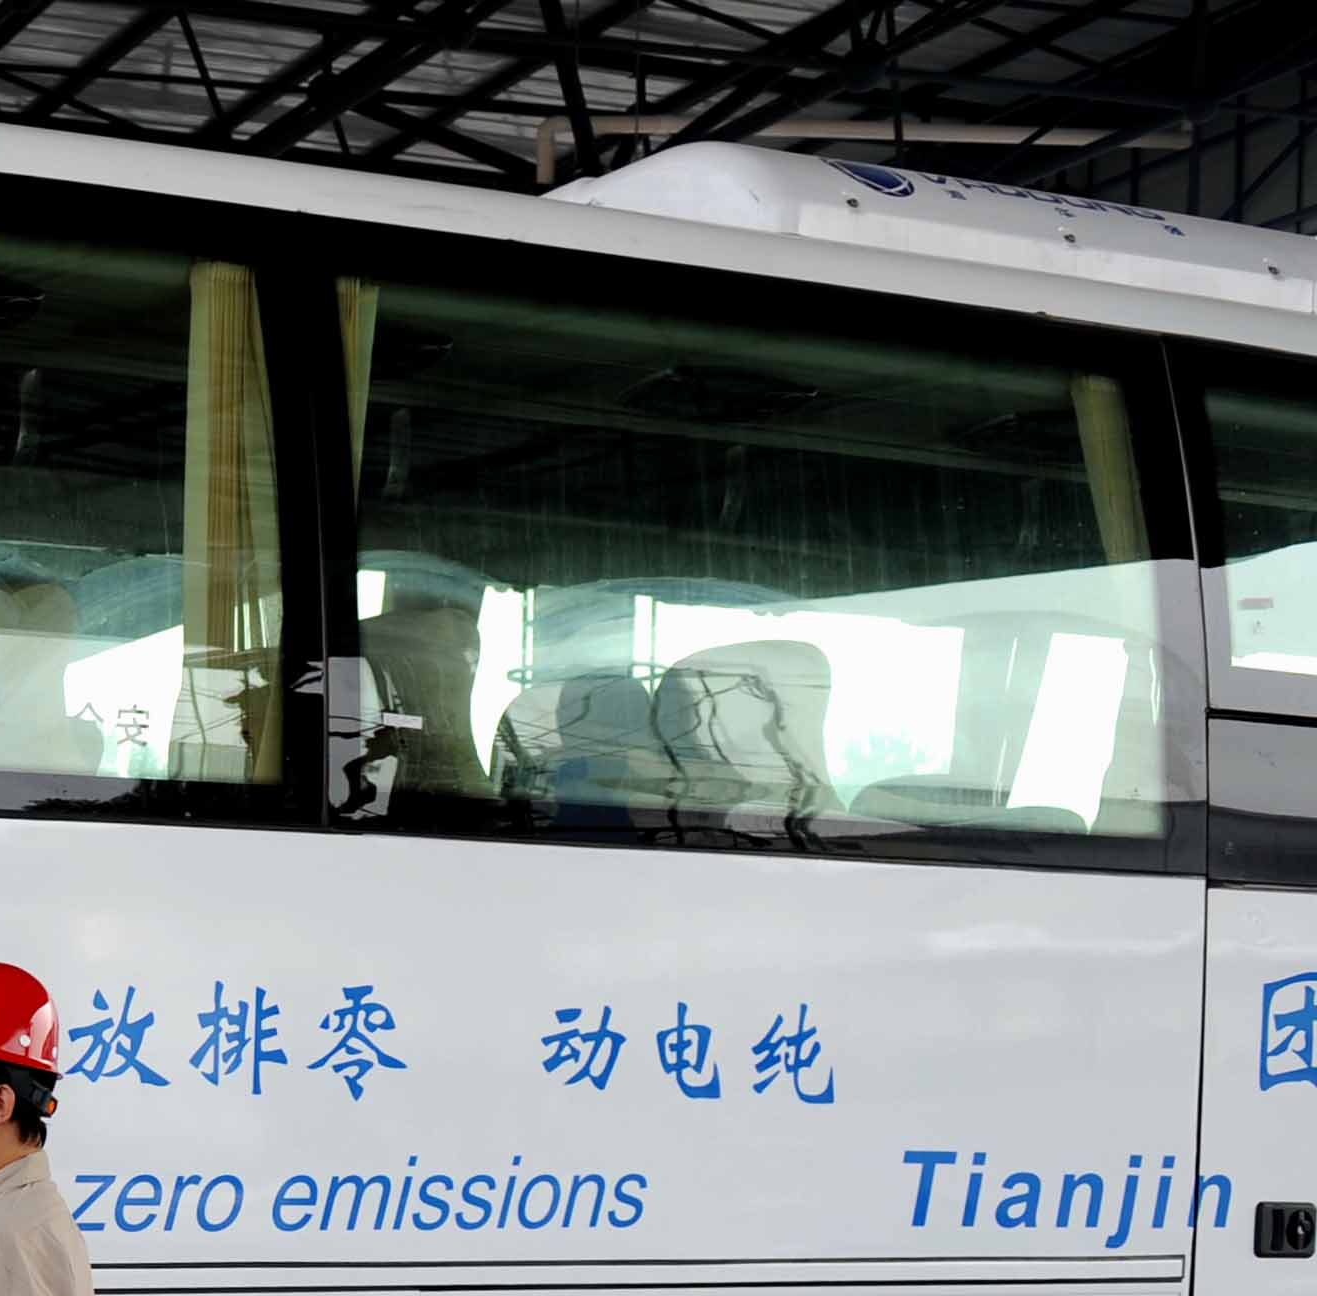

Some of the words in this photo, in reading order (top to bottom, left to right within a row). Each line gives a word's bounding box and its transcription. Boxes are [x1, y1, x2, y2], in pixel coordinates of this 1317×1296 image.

[72, 1172, 245, 1233] zero
[271, 1154, 649, 1233] emissions
[902, 1150, 1234, 1250] Tianjin
